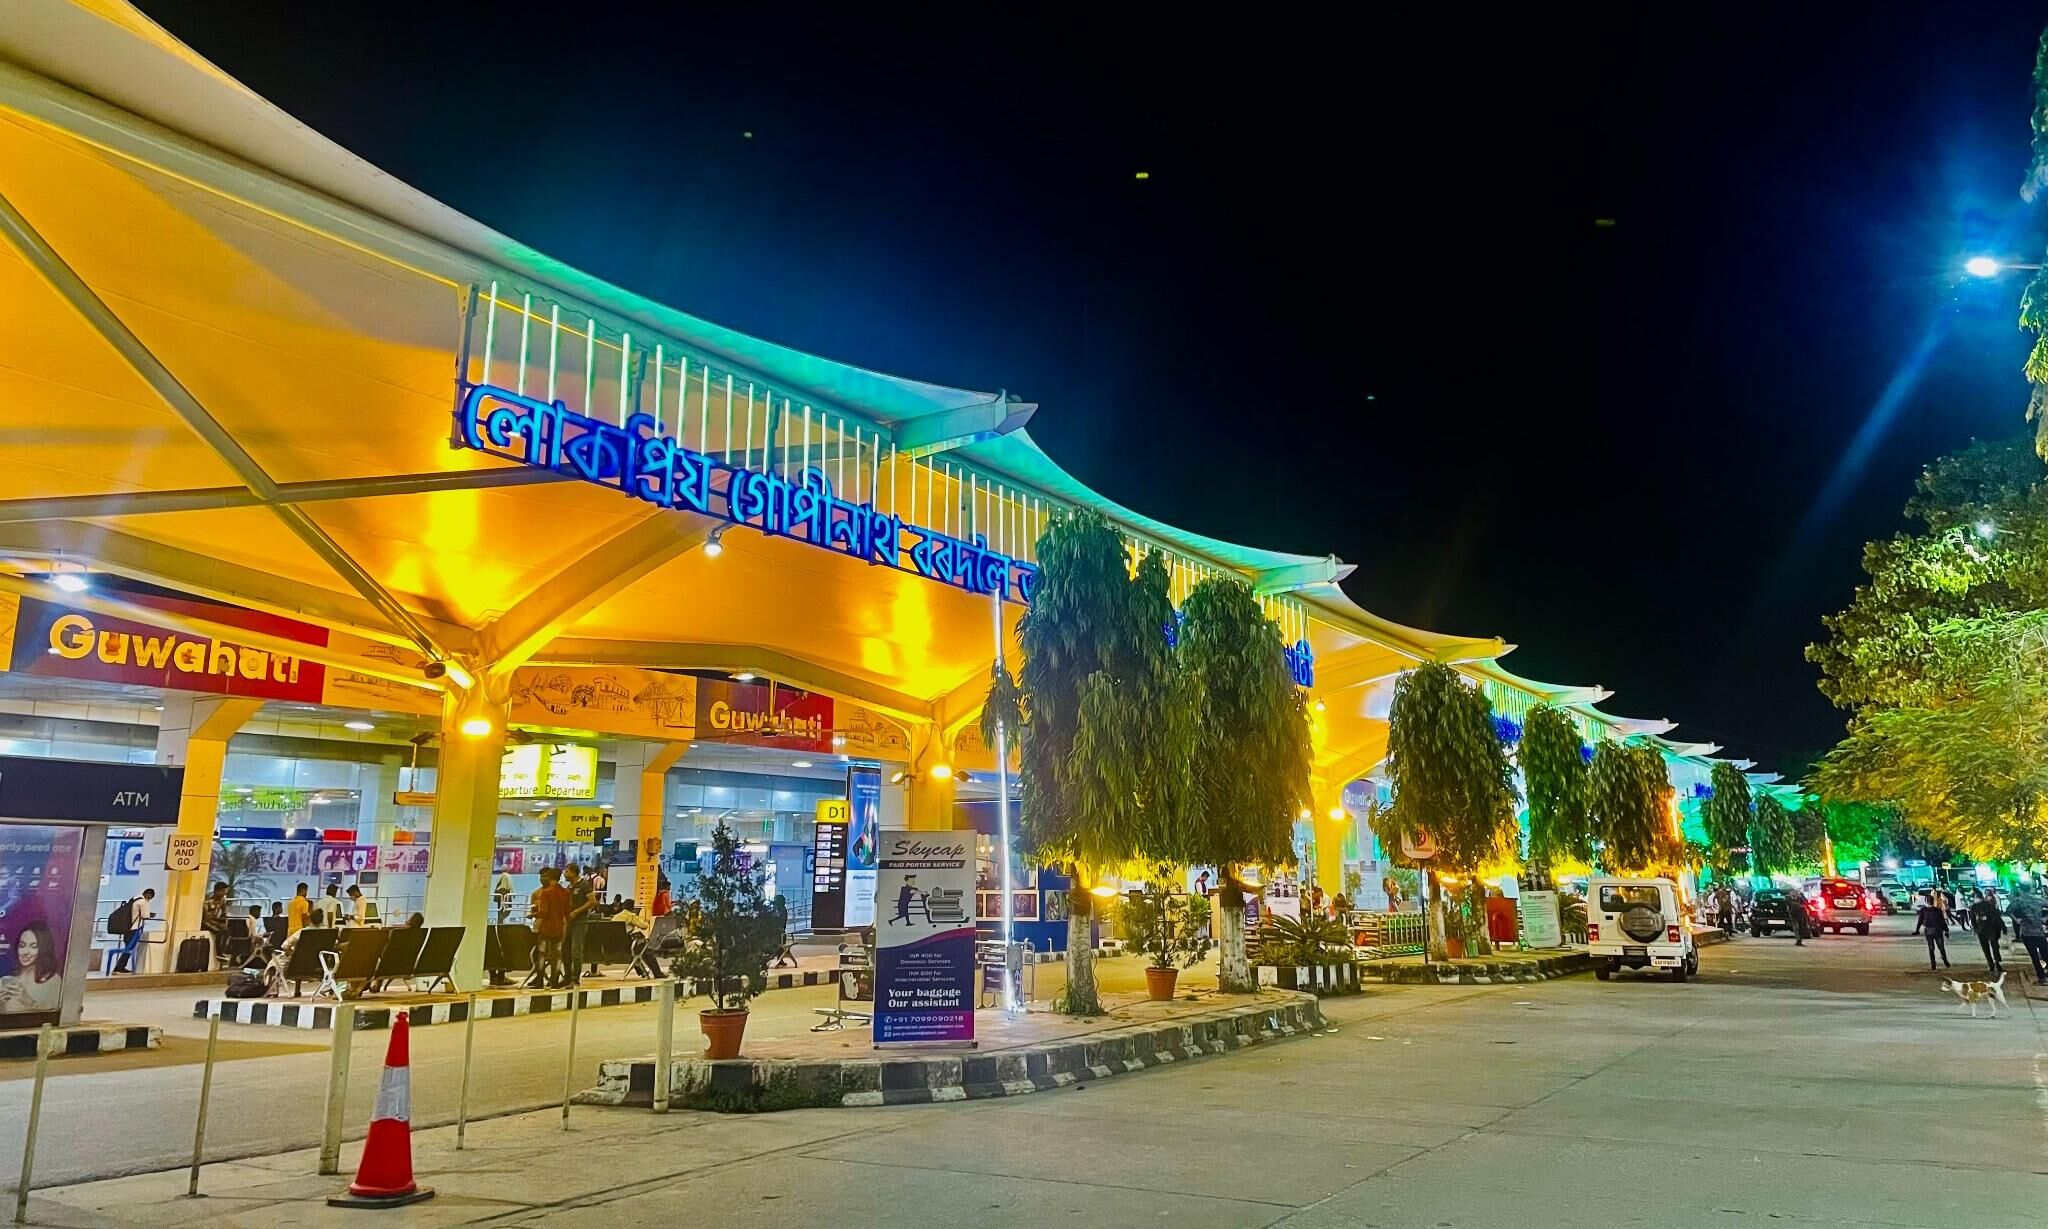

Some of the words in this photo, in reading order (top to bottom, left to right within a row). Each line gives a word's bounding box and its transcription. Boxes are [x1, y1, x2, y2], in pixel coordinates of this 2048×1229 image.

[499, 784, 538, 797] eparture
[544, 784, 591, 797] Departure
[112, 791, 150, 807] ATM
[828, 806, 845, 819] D1
[575, 827, 595, 837] Entr
[174, 839, 198, 848] DROP
[174, 848, 195, 857] AND
[892, 840, 966, 859] Skycap
[177, 857, 190, 866] GO
[888, 988, 914, 997] Your
[916, 988, 961, 998] baggage
[888, 999, 909, 1008] Our
[911, 998, 960, 1007] assistant
